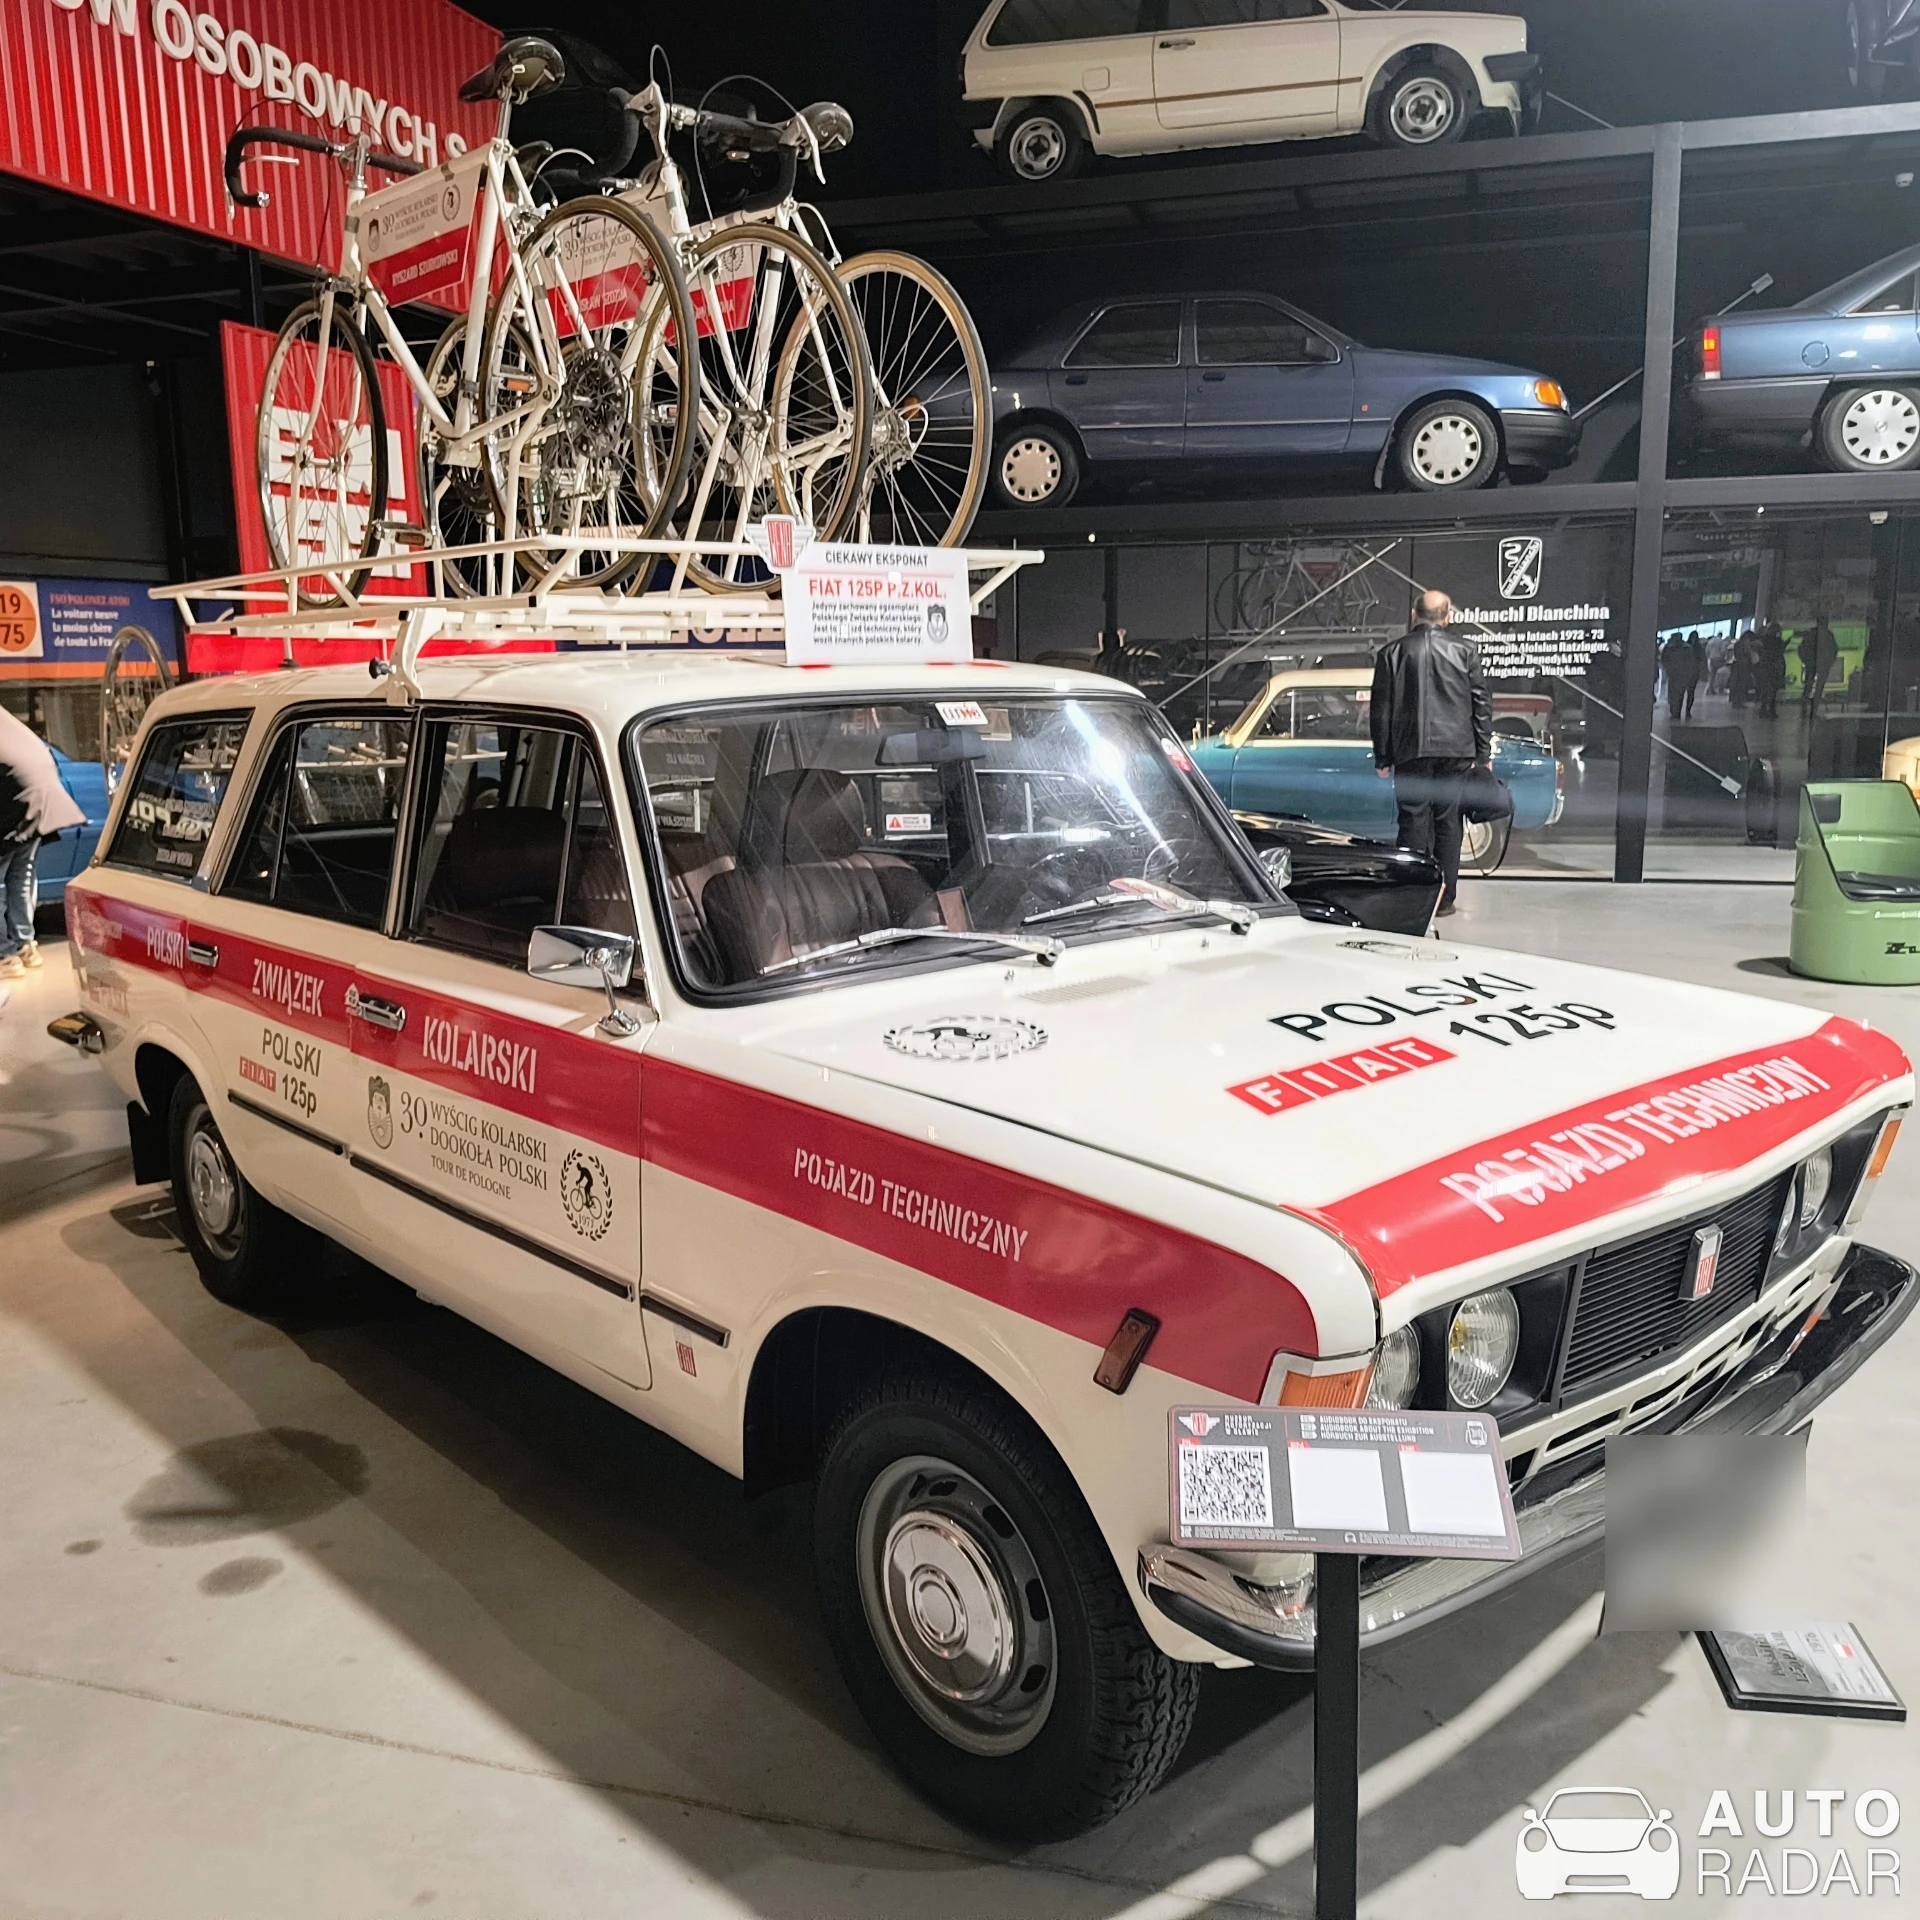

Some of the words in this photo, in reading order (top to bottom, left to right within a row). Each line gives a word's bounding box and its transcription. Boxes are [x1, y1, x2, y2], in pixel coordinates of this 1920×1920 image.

[152, 0, 438, 169] OSOBOWYCH
[825, 551, 873, 566] CIEKAWY
[876, 553, 929, 567] EKSPONAT
[0, 593, 21, 614] 19
[809, 578, 842, 597] FIAT
[848, 580, 883, 598] 125P
[812, 601, 837, 611] Jedyny
[839, 602, 877, 612] zachowany
[879, 602, 919, 612] egzemplarz
[0, 623, 25, 645] 75
[812, 613, 848, 622] Polskiego
[813, 624, 828, 632] Jest
[903, 624, 921, 633] który
[1517, 633, 1525, 642] w
[1526, 631, 1558, 642] latach
[1560, 630, 1583, 641] 1972
[1591, 629, 1604, 640] 73
[865, 636, 894, 646] polskich
[1482, 643, 1516, 655] Joseph
[147, 926, 184, 969] POLSKI
[252, 958, 324, 1017] ZWIĄZEK
[1268, 972, 1538, 1042] POLSKI
[262, 1028, 321, 1077] POLSKI
[423, 1016, 537, 1094] KOLARSKI
[1242, 1040, 1436, 1109] FIAT
[1449, 1000, 1617, 1047] 125p
[240, 1057, 276, 1091] FIAT
[281, 1074, 317, 1118] 125p
[400, 1091, 428, 1139] 30.
[430, 1100, 478, 1136] WYŚCIG
[481, 1120, 547, 1163] KOLARSKI
[1438, 1122, 1646, 1223] POJAZD
[1604, 1055, 1831, 1144] TECHNICZNY
[430, 1127, 494, 1170] DOOKOŁA
[499, 1152, 548, 1191] POLSKI
[431, 1155, 454, 1177] TOUR
[455, 1165, 468, 1182] DE
[468, 1170, 512, 1200] POLOGNE
[794, 1148, 875, 1205] POJAZD
[881, 1179, 1028, 1262] TECHNICZNY
